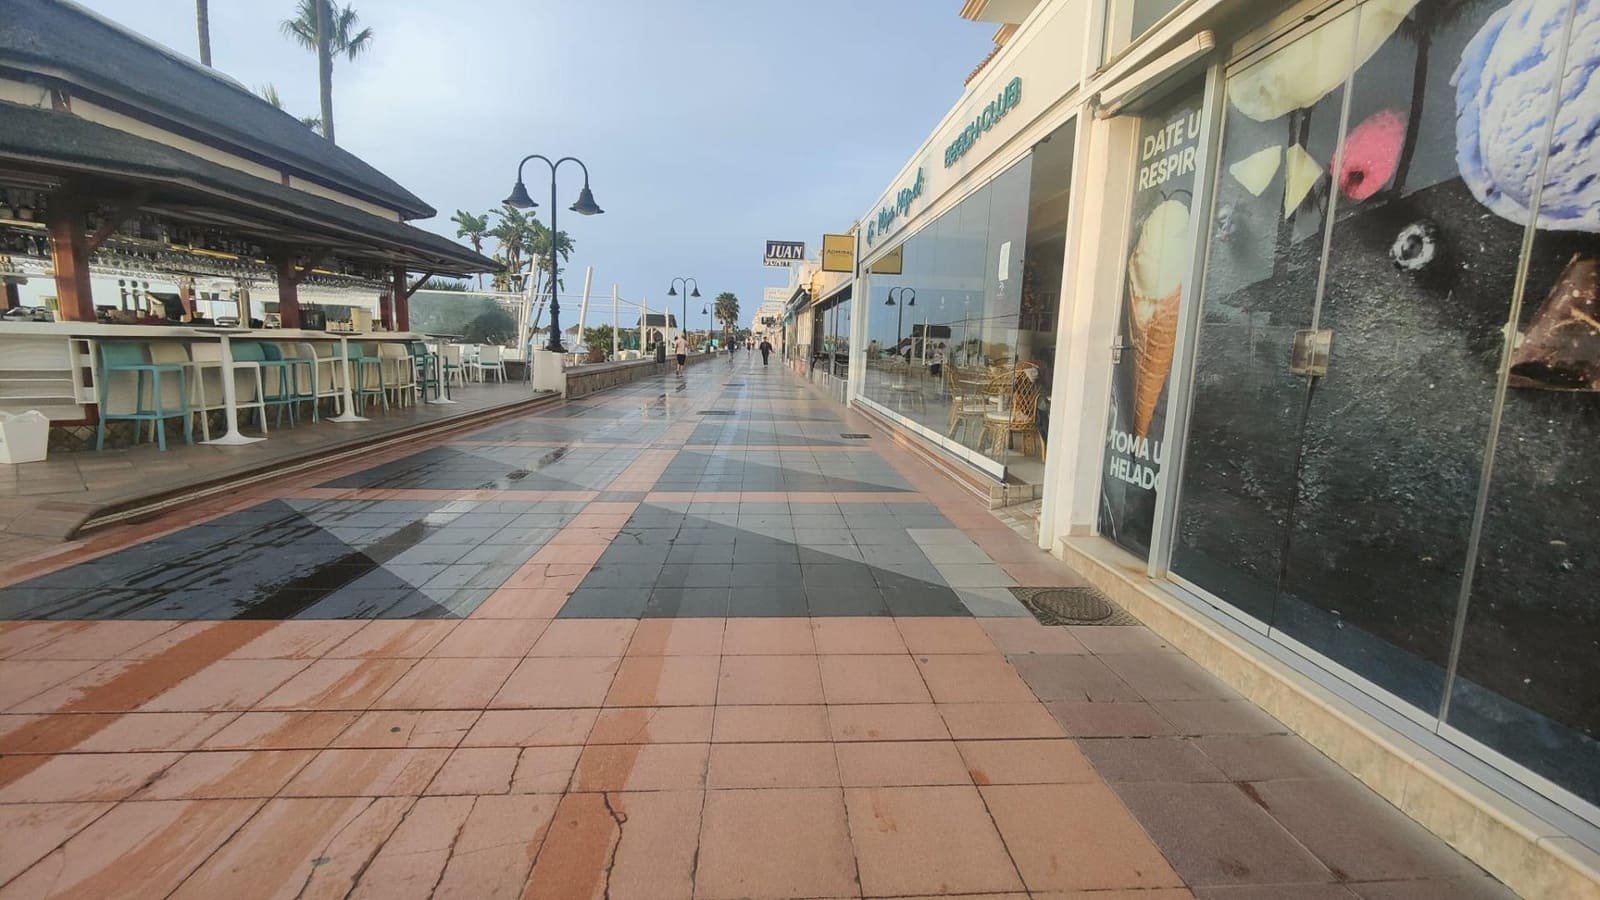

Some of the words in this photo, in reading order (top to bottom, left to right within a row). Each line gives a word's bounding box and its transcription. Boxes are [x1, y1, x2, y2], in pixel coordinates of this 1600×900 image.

[944, 115, 981, 169] BEACH
[981, 76, 1022, 133] CLUB
[1143, 118, 1185, 161] DATE
[767, 244, 803, 259] JUAN
[1110, 430, 1150, 461] TOMA
